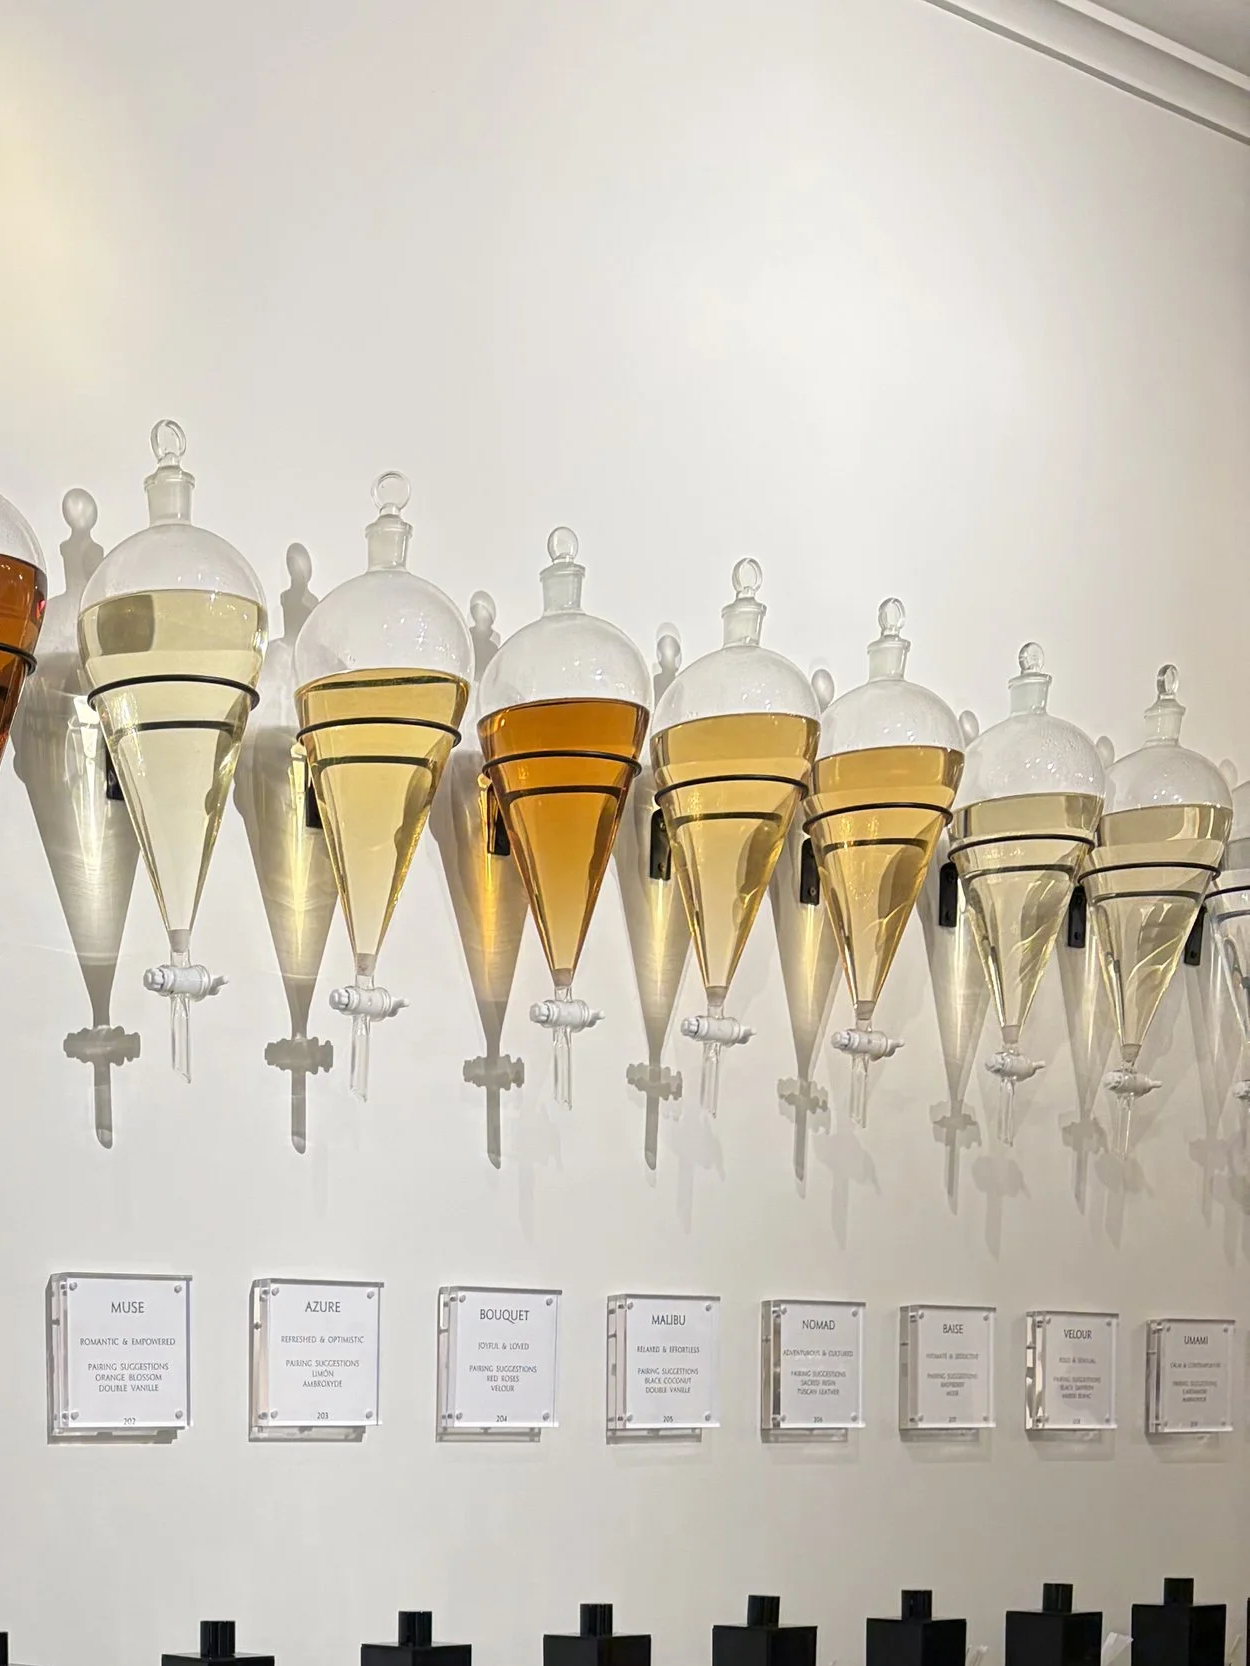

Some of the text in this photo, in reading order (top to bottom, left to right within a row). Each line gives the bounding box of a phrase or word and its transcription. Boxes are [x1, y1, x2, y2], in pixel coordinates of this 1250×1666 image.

[111, 1302, 145, 1313] MUSE
[305, 1302, 341, 1312] AZURE
[480, 1309, 530, 1324] BOUQUET
[652, 1315, 686, 1326] MALIBU
[802, 1320, 835, 1330] NOMAD
[943, 1324, 964, 1334] BAISE
[1064, 1329, 1092, 1339] VELOUR
[80, 1338, 119, 1346] ROMANTIC
[132, 1338, 176, 1346] EMPOWERED
[328, 1336, 364, 1344] OPTIMISTIC
[1184, 1336, 1208, 1345] UMAMI
[478, 1342, 499, 1350] JOYFUL
[670, 1346, 700, 1354] EFFORTLESS
[88, 1363, 117, 1371] PAIRING
[496, 1365, 537, 1373] SUGGESTIONS
[303, 1380, 342, 1388] AMBROXYDE
[317, 1412, 328, 1420] 203
[497, 1415, 507, 1423] 204
